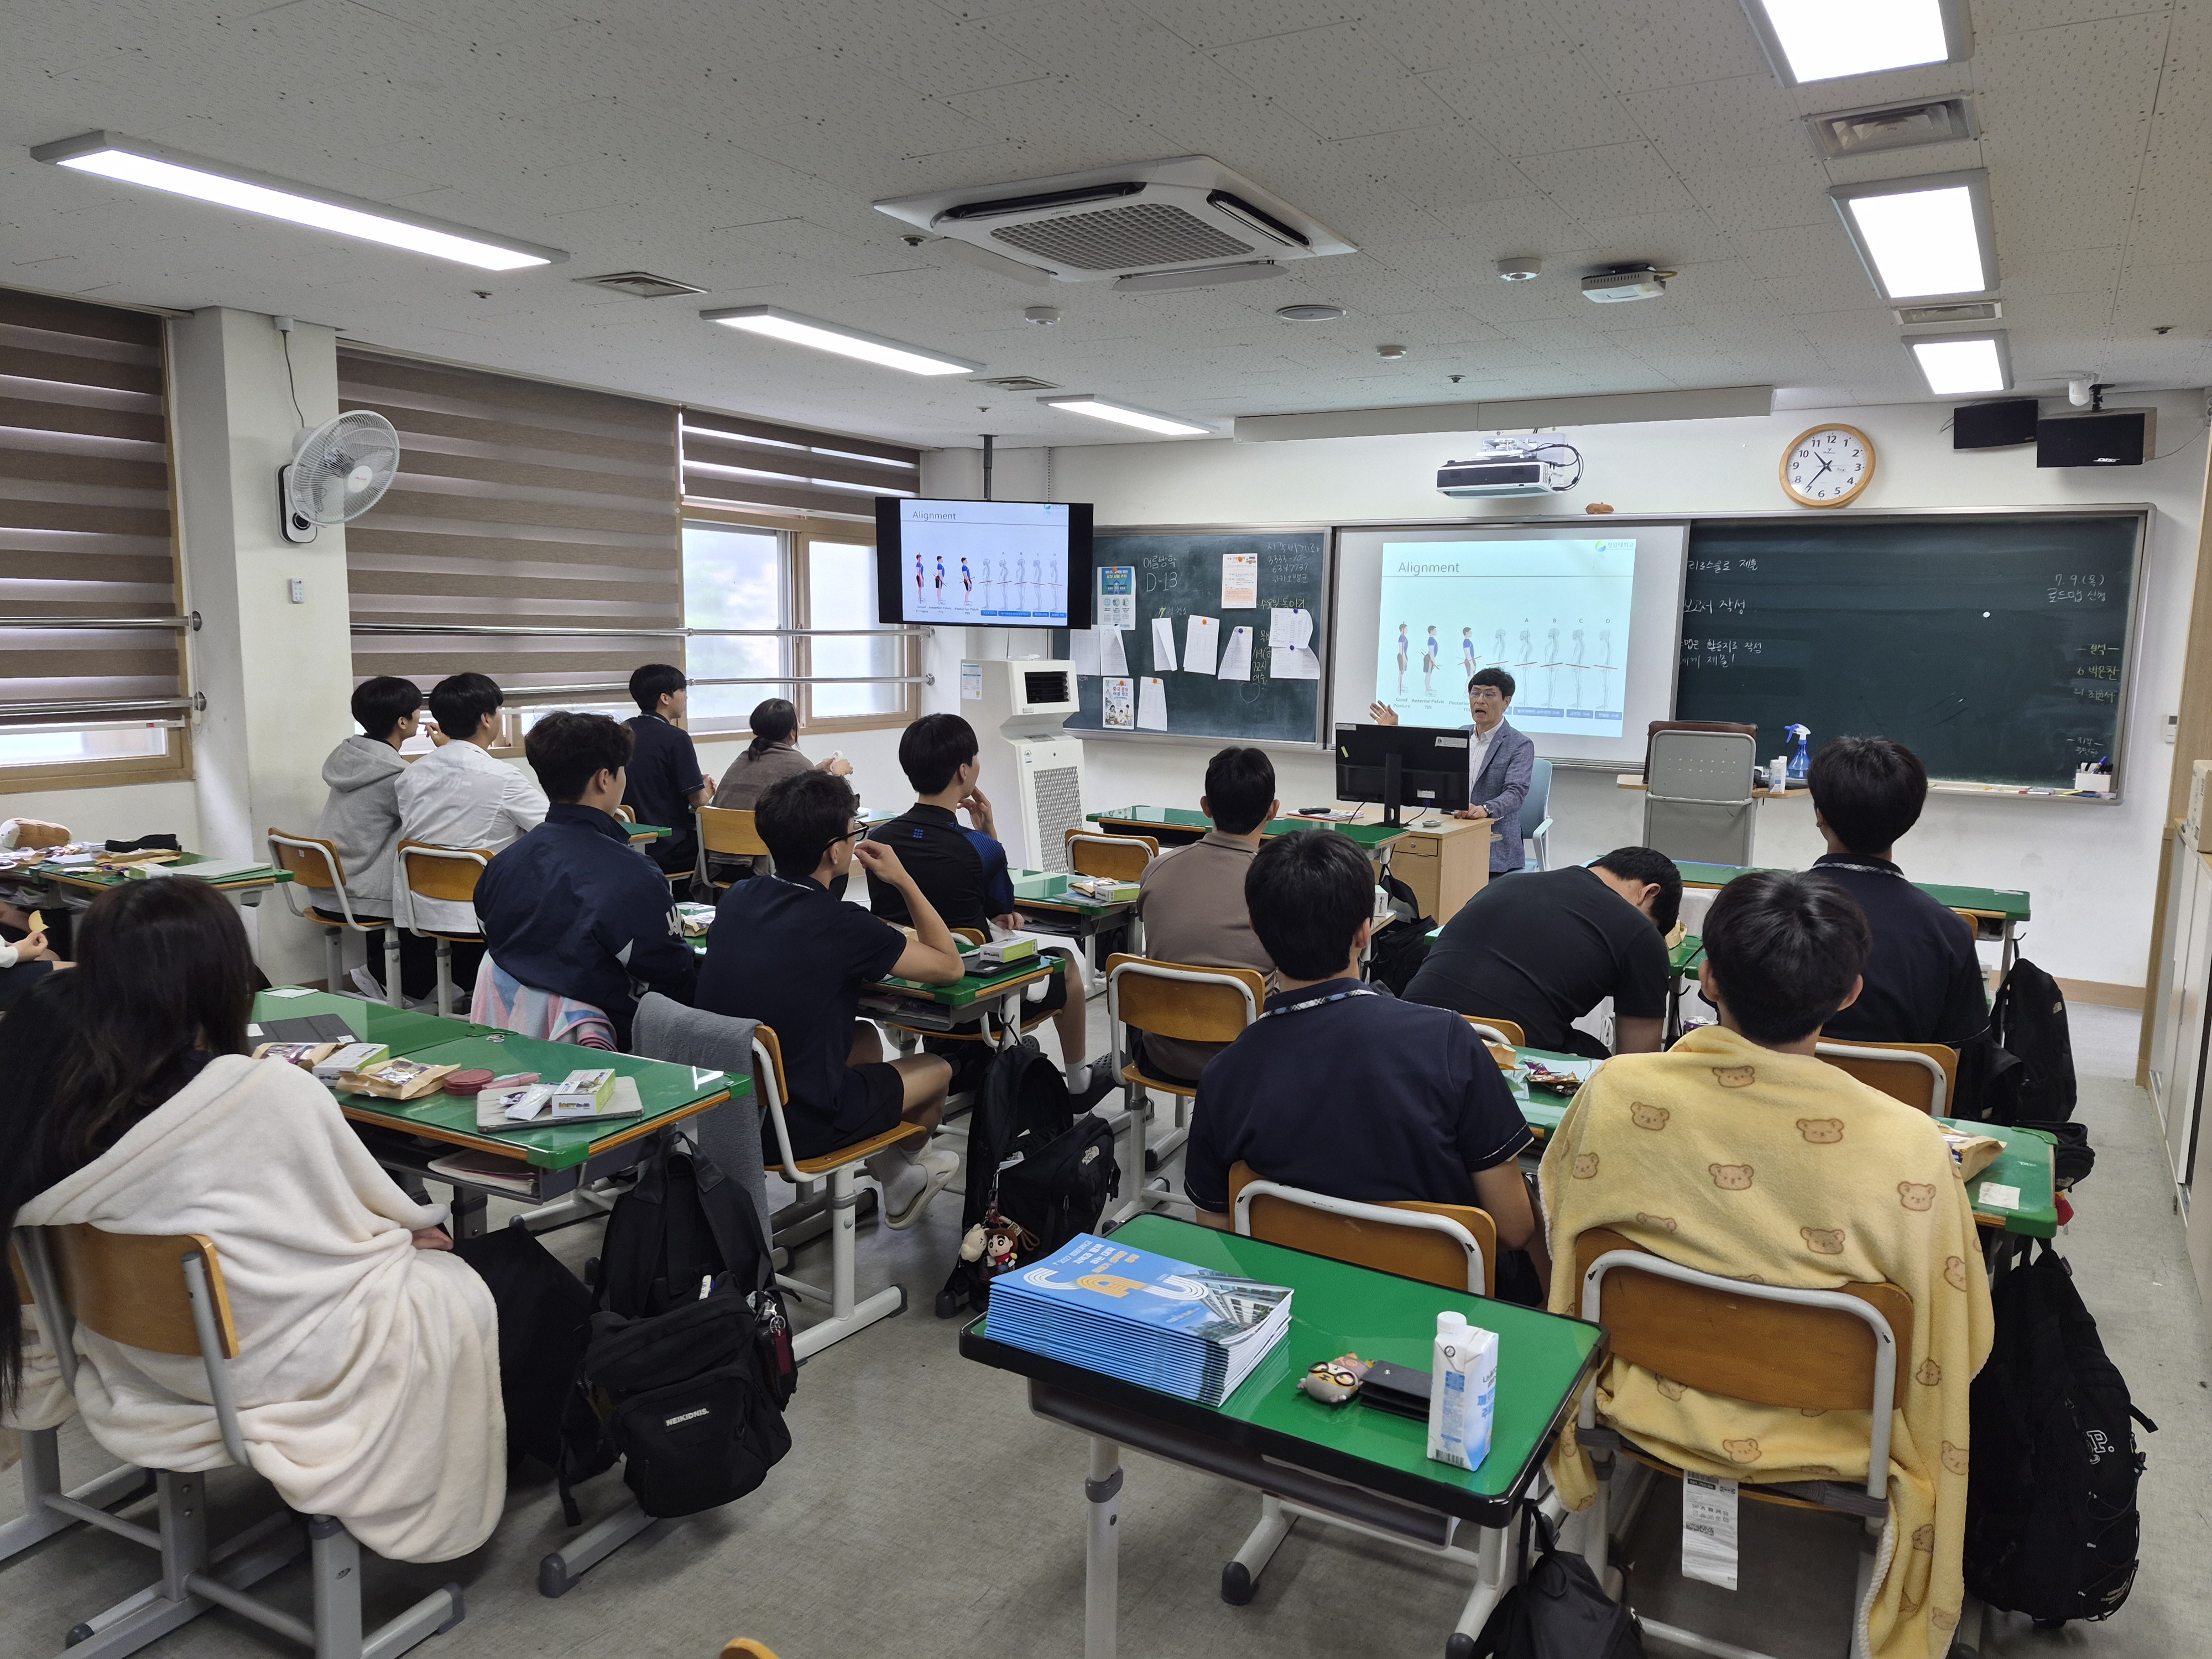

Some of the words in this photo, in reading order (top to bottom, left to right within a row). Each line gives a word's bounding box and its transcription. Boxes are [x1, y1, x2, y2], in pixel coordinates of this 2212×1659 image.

[1812, 439, 1820, 447] 11
[1827, 435, 1837, 444] 12
[1799, 450, 1809, 458] 10
[1846, 477, 1854, 485] 4
[912, 511, 956, 521] Alignment
[1143, 554, 1177, 569] 여름방학
[1398, 562, 1459, 576] Alignment
[1146, 571, 1178, 592] D-13
[1719, 598, 1745, 615] 작성
[1681, 638, 1699, 650] 맵은
